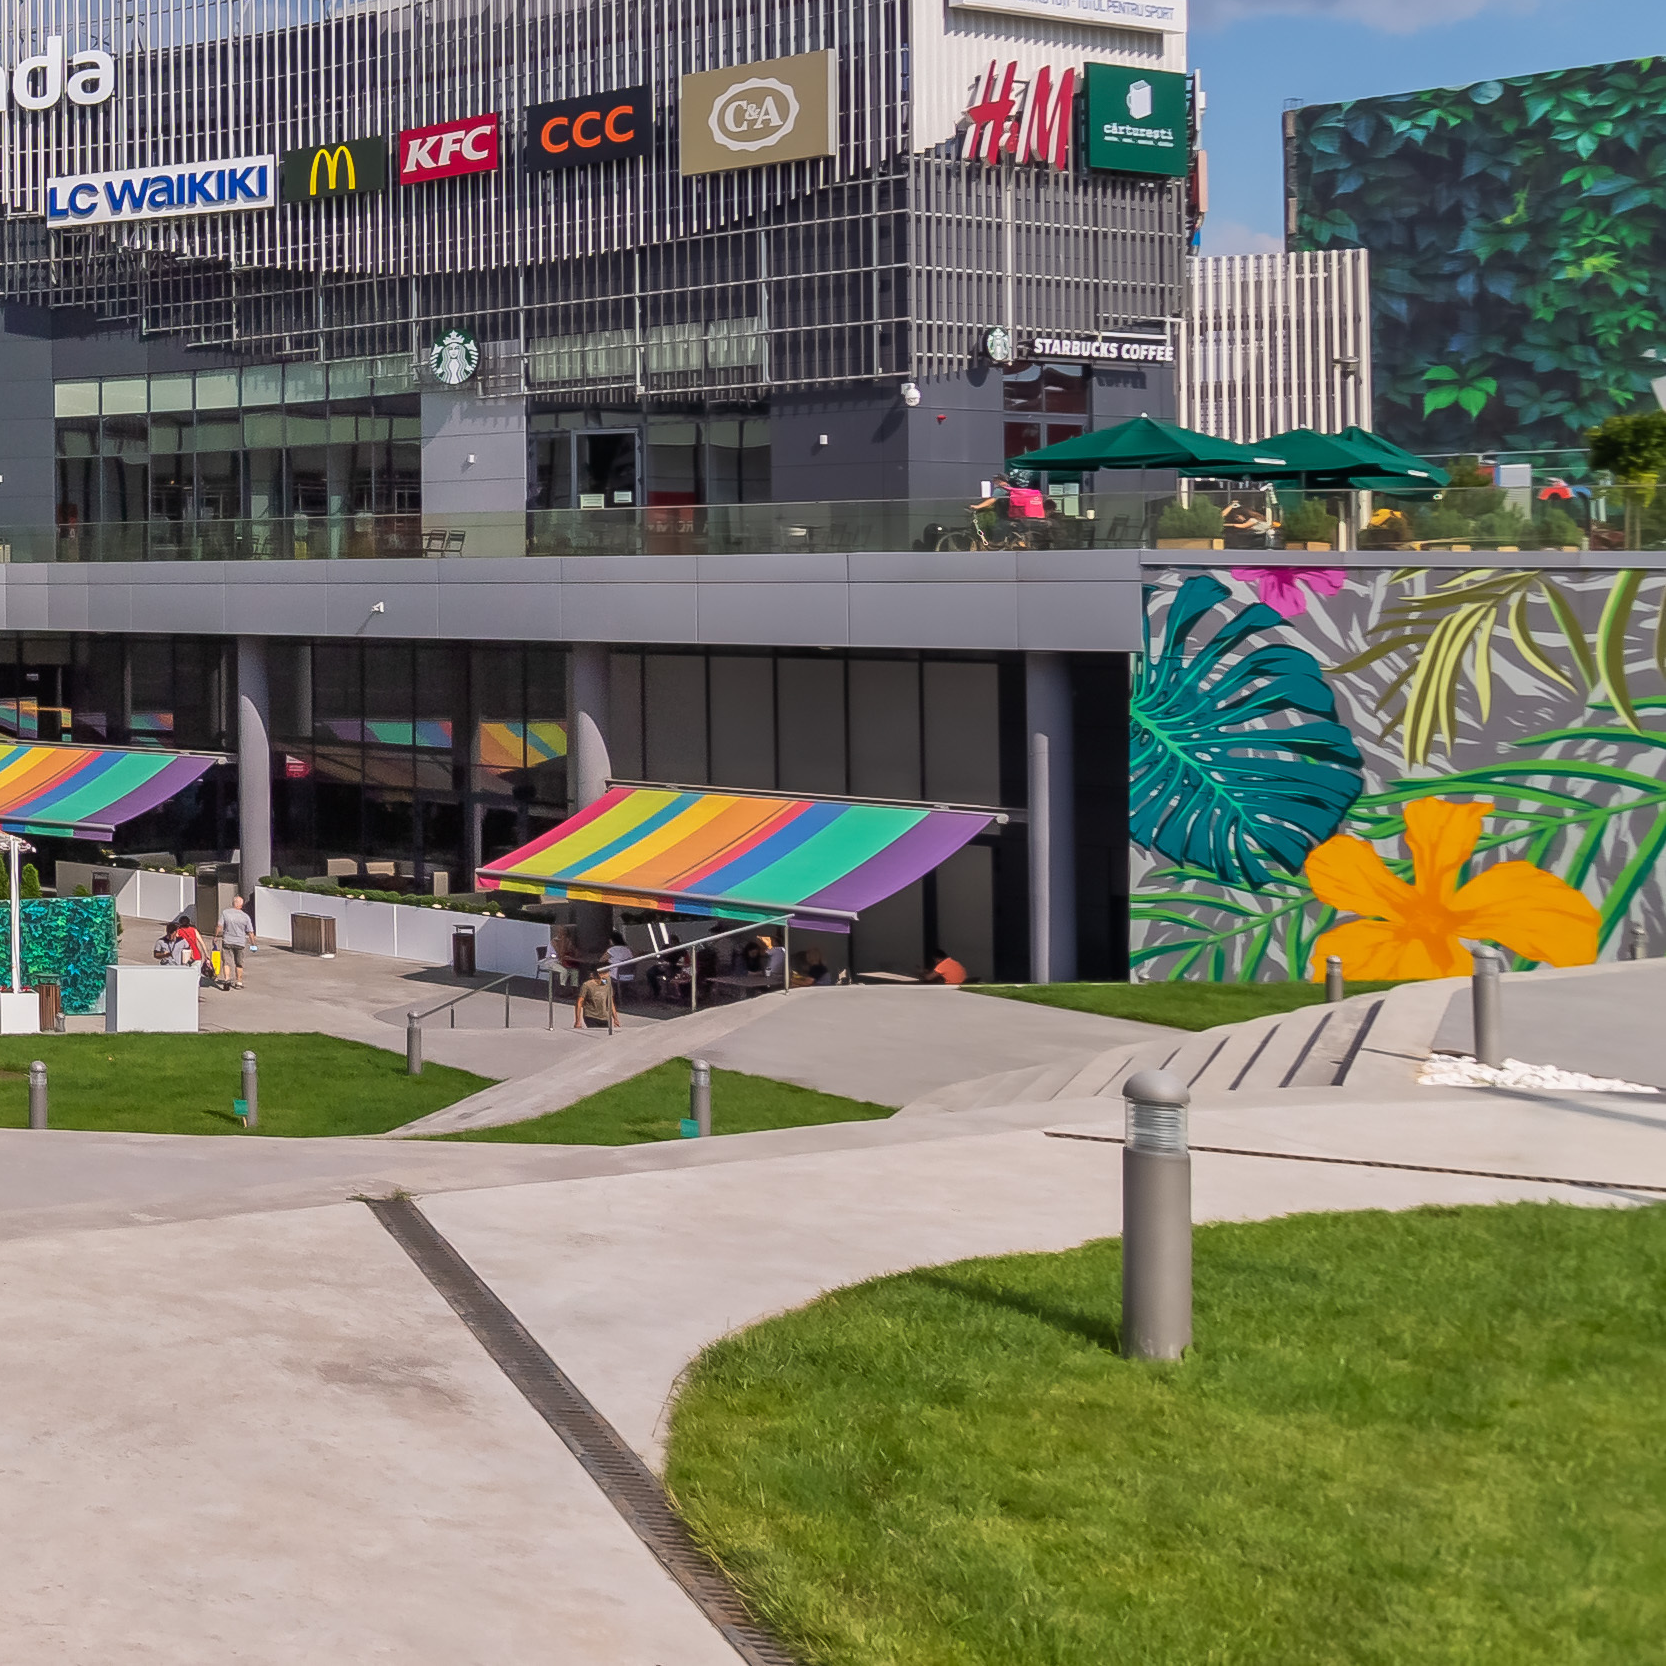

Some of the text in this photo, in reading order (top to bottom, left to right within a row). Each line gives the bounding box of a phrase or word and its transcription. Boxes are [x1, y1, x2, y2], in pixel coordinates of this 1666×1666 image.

[1107, 0, 1145, 17] PENTRU
[1145, 4, 1175, 20] SPORT
[541, 105, 635, 153] CCC
[724, 96, 783, 132] C&A
[966, 59, 1075, 171] H&M
[403, 125, 493, 174] KFC
[48, 183, 98, 218] LC
[1034, 338, 1175, 362] STARBUCKS COFFEE
